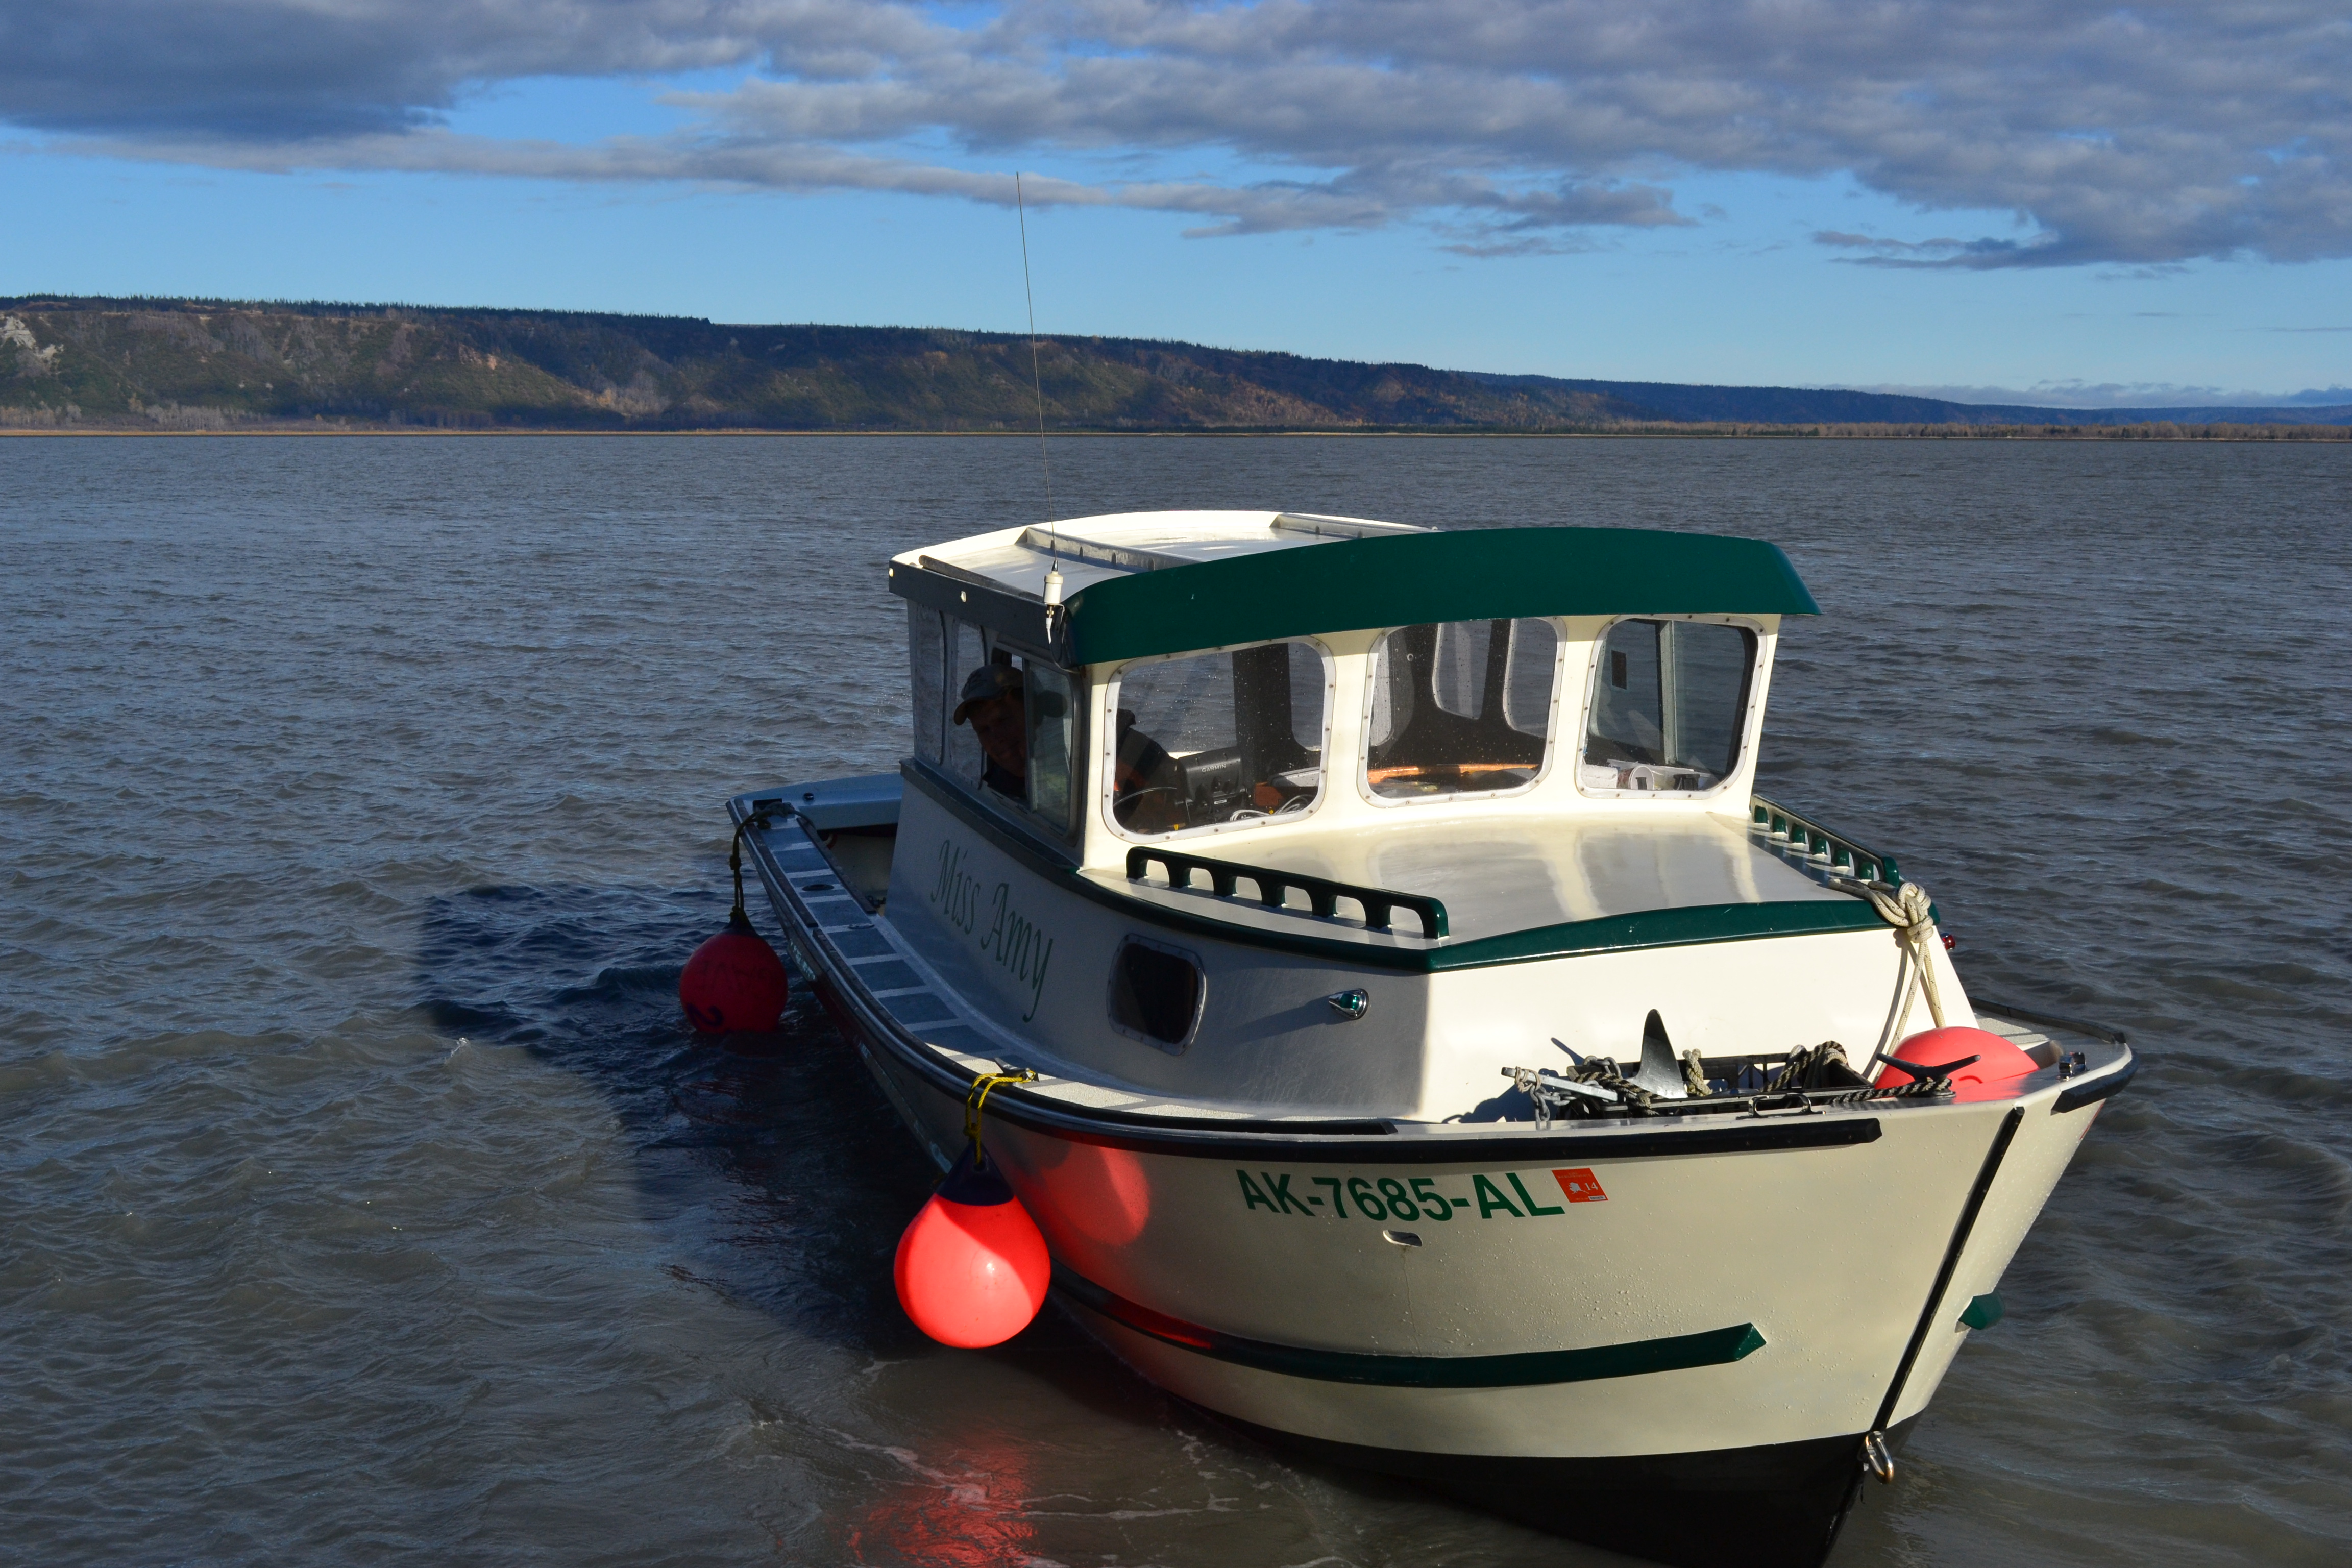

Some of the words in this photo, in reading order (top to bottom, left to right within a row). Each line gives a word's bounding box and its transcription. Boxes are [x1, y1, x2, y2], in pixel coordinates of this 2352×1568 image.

[1202, 763, 1227, 772] GARMIN
[930, 839, 981, 935] Miss
[980, 883, 1054, 1023] Amy
[1236, 1169, 1566, 1222] AK-7685-AL
[1584, 1181, 1599, 1191] 14
